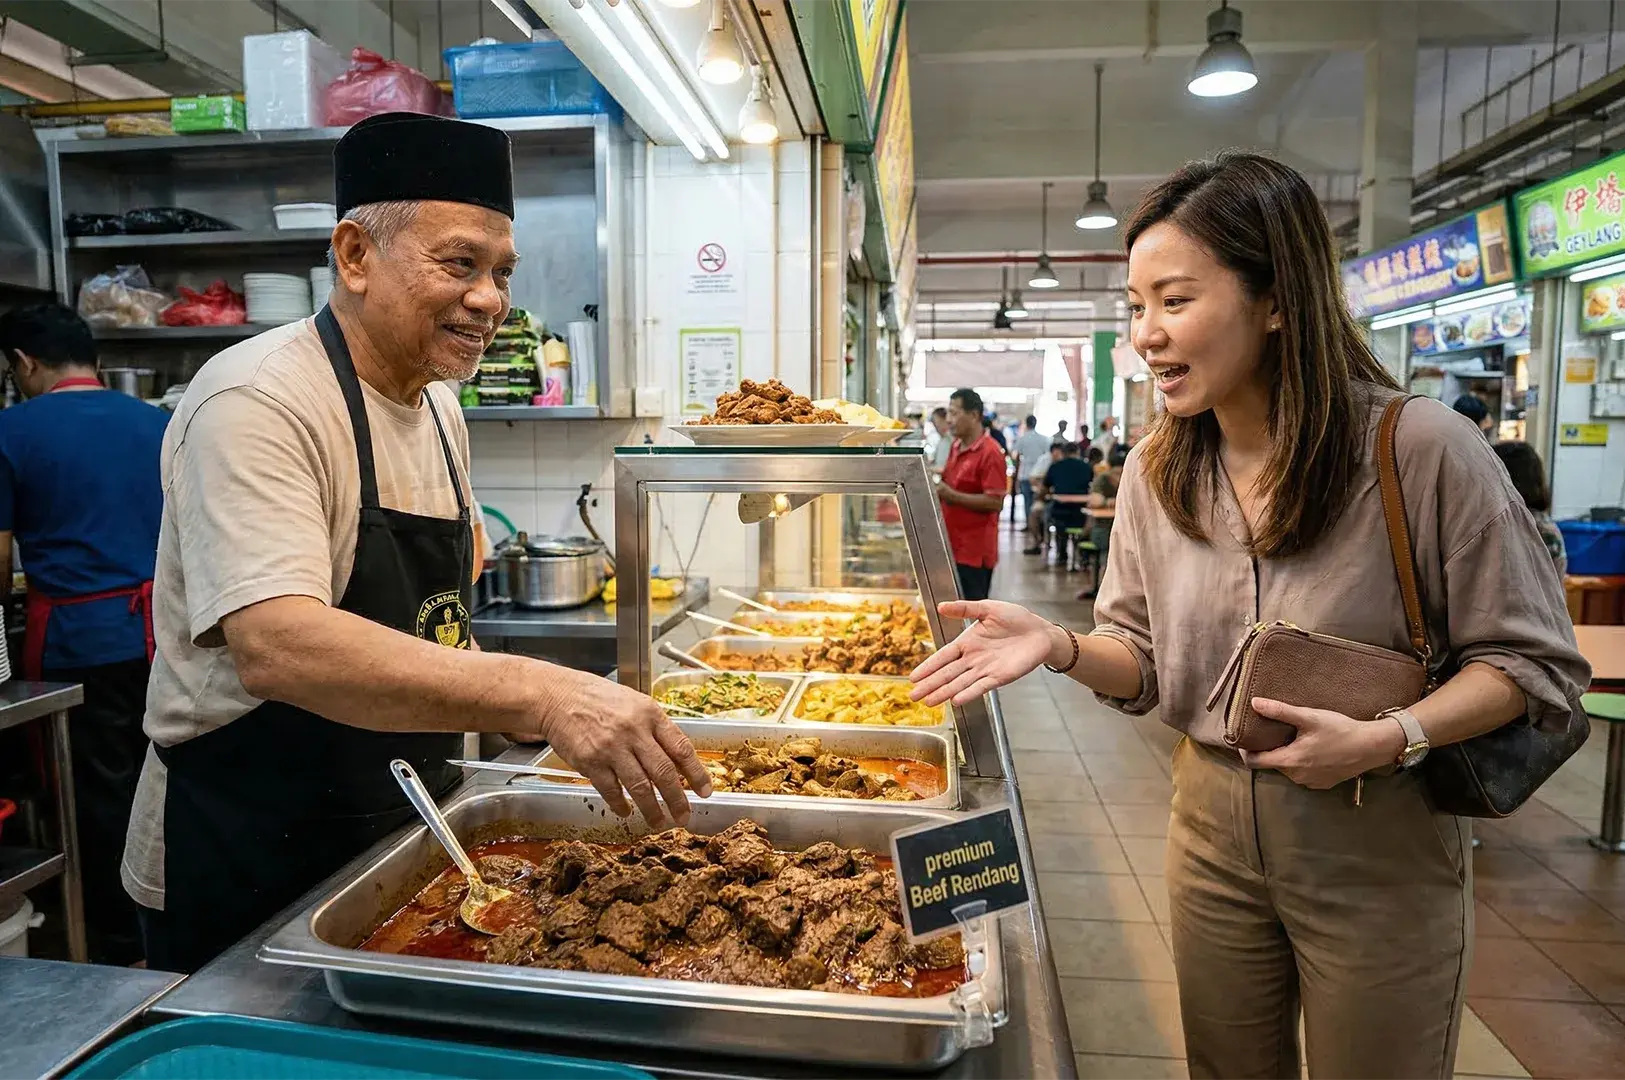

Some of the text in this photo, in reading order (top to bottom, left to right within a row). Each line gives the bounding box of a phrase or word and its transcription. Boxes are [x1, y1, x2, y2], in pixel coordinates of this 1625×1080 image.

[1565, 222, 1622, 254] GEYLANG
[924, 840, 995, 878] premium
[909, 862, 1019, 908] Beef Rendang
